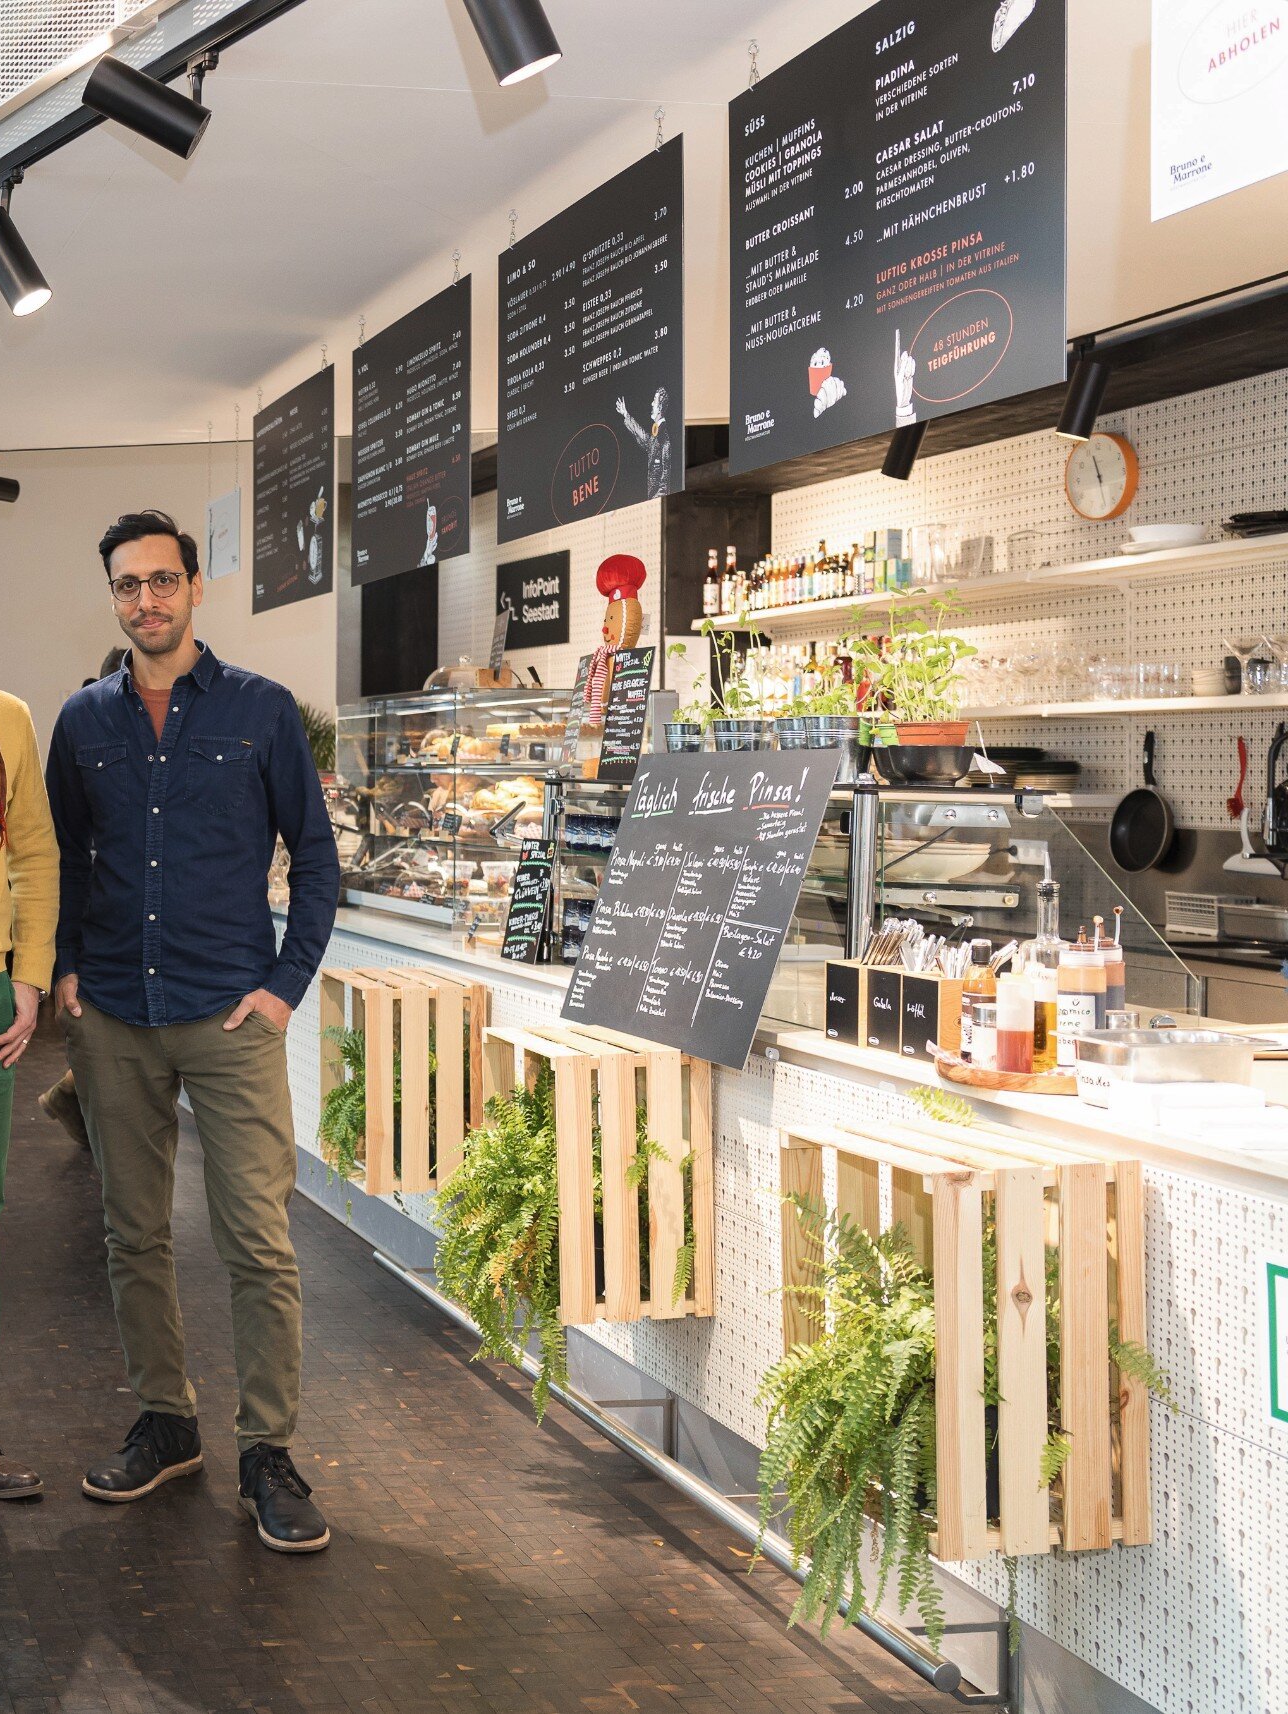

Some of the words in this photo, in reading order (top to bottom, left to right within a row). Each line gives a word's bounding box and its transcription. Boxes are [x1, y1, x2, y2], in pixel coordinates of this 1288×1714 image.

[875, 21, 914, 54] SALZIG
[1208, 18, 1280, 72] ABHOLEN
[875, 60, 914, 90] PIADINA
[875, 71, 926, 106] VERSCHIEDENE
[929, 53, 957, 76] SORTEN
[1013, 73, 1034, 94] 7.10
[876, 110, 883, 121] IN
[886, 102, 897, 115] DER
[900, 86, 927, 106] VITRINE
[745, 115, 764, 136] SÜSS
[876, 161, 901, 180] CAESAR
[904, 142, 941, 166] DRESSING,
[945, 101, 1022, 145] BUTTER-CROUTONS,
[876, 138, 910, 163] CAESAR
[914, 120, 943, 144] SALAT
[745, 144, 772, 167] KUCHEN
[782, 118, 814, 145] MUFFINS
[745, 157, 775, 182] COOKIES
[785, 130, 822, 158] GRANOLA
[745, 177, 765, 196] MÜSLI
[768, 168, 780, 184] MIT
[783, 146, 821, 174] TOPPINGS
[771, 187, 777, 197] IN
[779, 181, 789, 192] DER
[790, 168, 812, 185] VITRINE
[876, 160, 936, 194] PARMESANHOBEL,
[940, 143, 969, 163] OLIVEN,
[1005, 162, 1034, 182] +1.80
[1170, 159, 1197, 175] Bruno
[1174, 162, 1212, 184] Marrone
[845, 181, 863, 198] 2.00
[876, 175, 933, 209] KIRSCHTOMATEN
[902, 183, 985, 230] HÄHNCHENBRUST
[745, 229, 769, 249] BUTTER
[772, 206, 813, 235] CROISSANT
[845, 229, 863, 245] 4.50
[745, 272, 772, 292] STAUD'S
[775, 250, 818, 278] MARMELADE
[764, 249, 788, 268] BUTTER
[791, 245, 796, 256] &
[876, 262, 906, 283] LUFTIG
[910, 245, 947, 269] KROSSE
[951, 231, 982, 252] PINSA
[876, 285, 895, 299] GANZ
[919, 269, 936, 282] HALB
[946, 262, 954, 272] IN
[958, 255, 971, 267] DER
[974, 242, 1004, 260] VITRINE
[582, 296, 598, 311] EISTEE
[845, 293, 863, 308] 4.20
[745, 311, 820, 350] NUSS-NOUGATCREME
[764, 309, 788, 328] BUTTER
[791, 306, 796, 316] &
[934, 340, 944, 352] 48
[946, 317, 988, 346] STUNDEN
[928, 332, 996, 372] TEIGFÜHRUNG
[745, 412, 764, 425] Bruno
[766, 410, 770, 418] e
[747, 418, 774, 434] Marrone
[569, 448, 600, 480] TUTTO
[573, 475, 599, 506] BENE
[522, 576, 560, 599] InfoPoint
[522, 600, 560, 624] Seestadt
[634, 772, 678, 818] Täglich
[692, 771, 736, 811] frische
[749, 767, 810, 806] Pinsa!
[722, 926, 776, 946] Beilagen-Salat
